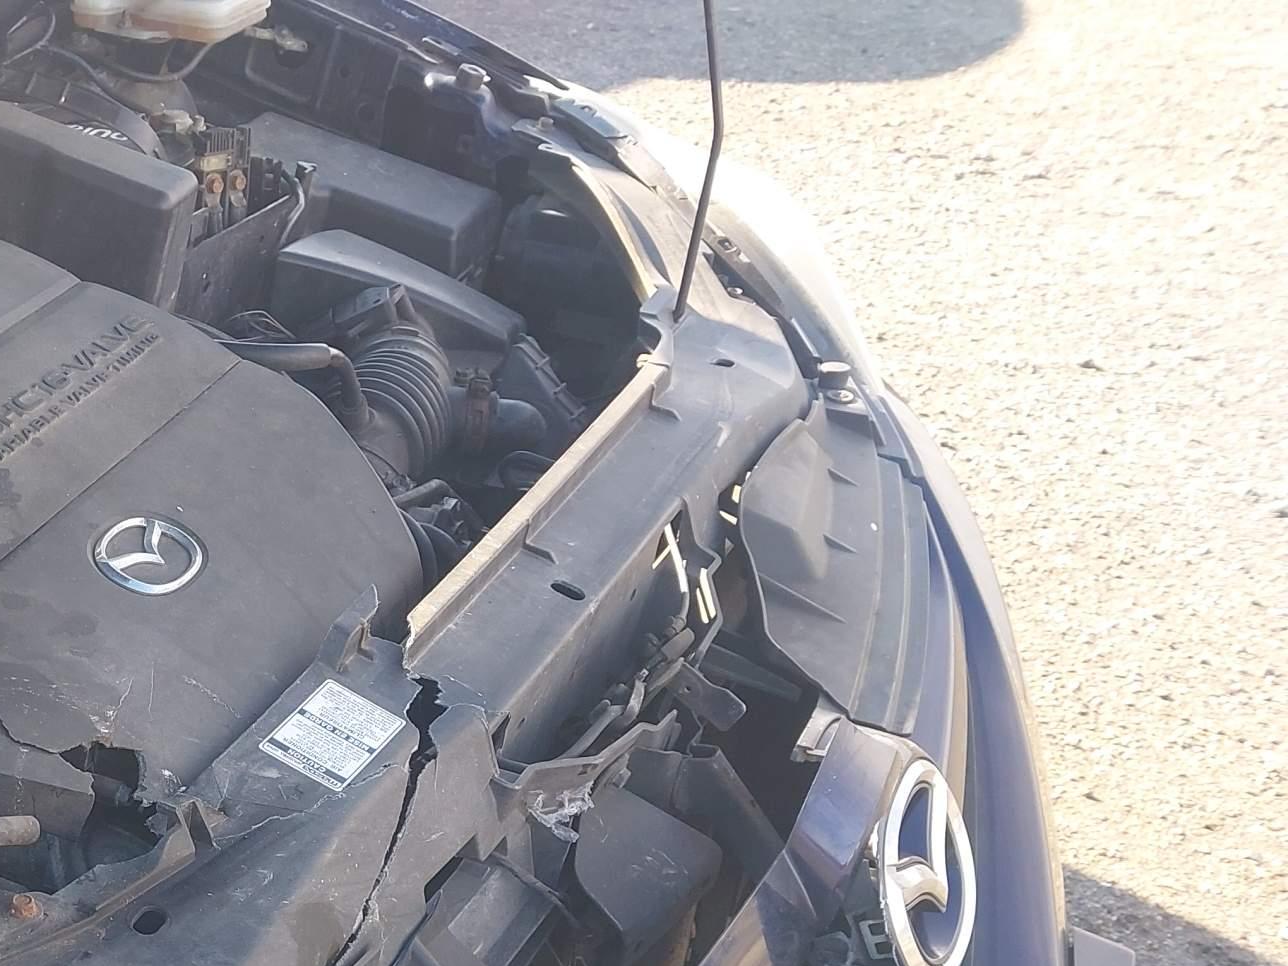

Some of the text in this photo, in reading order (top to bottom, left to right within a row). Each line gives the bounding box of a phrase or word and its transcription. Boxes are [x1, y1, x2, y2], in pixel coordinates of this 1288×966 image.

[65, 372, 111, 409] VALVE
[107, 333, 160, 373] TIMING
[333, 727, 348, 739] EN
[287, 748, 326, 773] CAUTION
